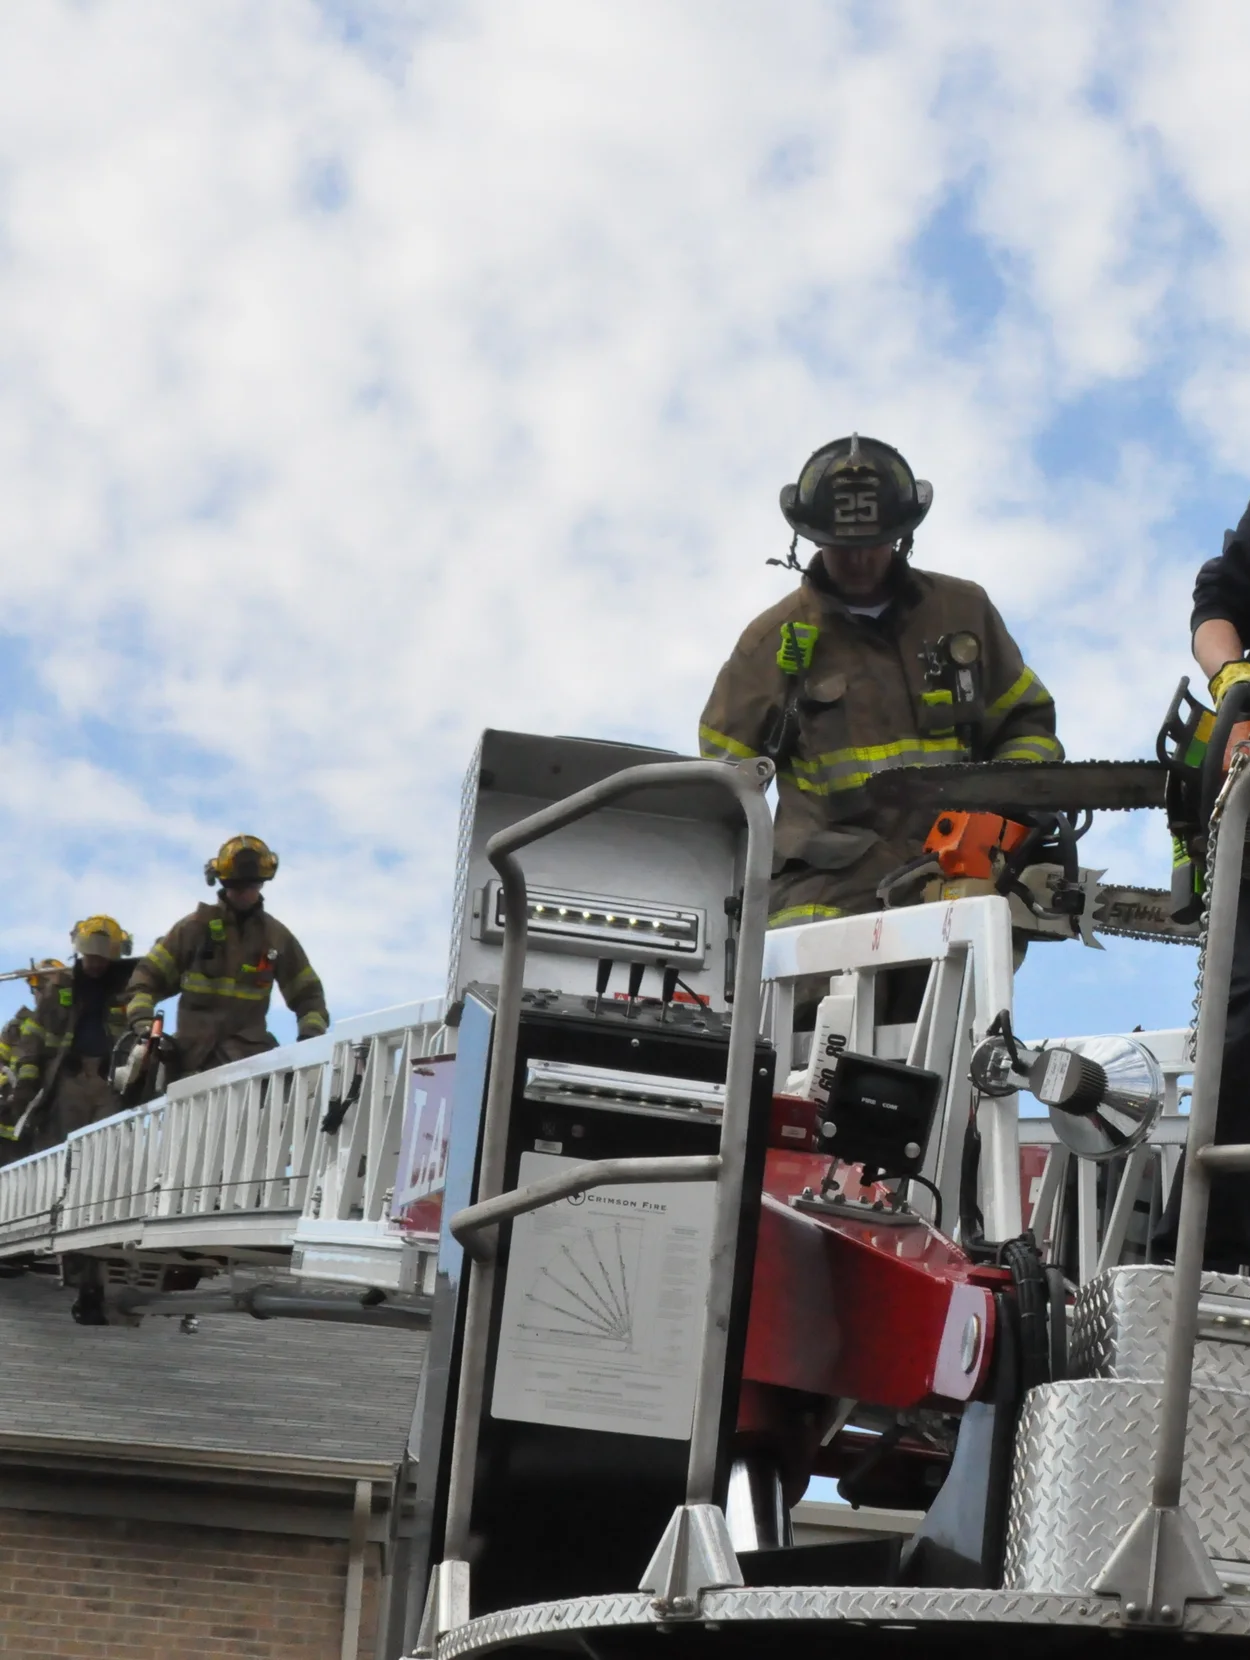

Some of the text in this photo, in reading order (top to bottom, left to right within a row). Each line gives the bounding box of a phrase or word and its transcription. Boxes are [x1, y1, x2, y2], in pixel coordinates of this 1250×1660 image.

[834, 492, 877, 522] 25
[826, 1033, 847, 1059] 80
[587, 1194, 637, 1208] CRIMSON
[642, 1201, 667, 1211] FIRE
